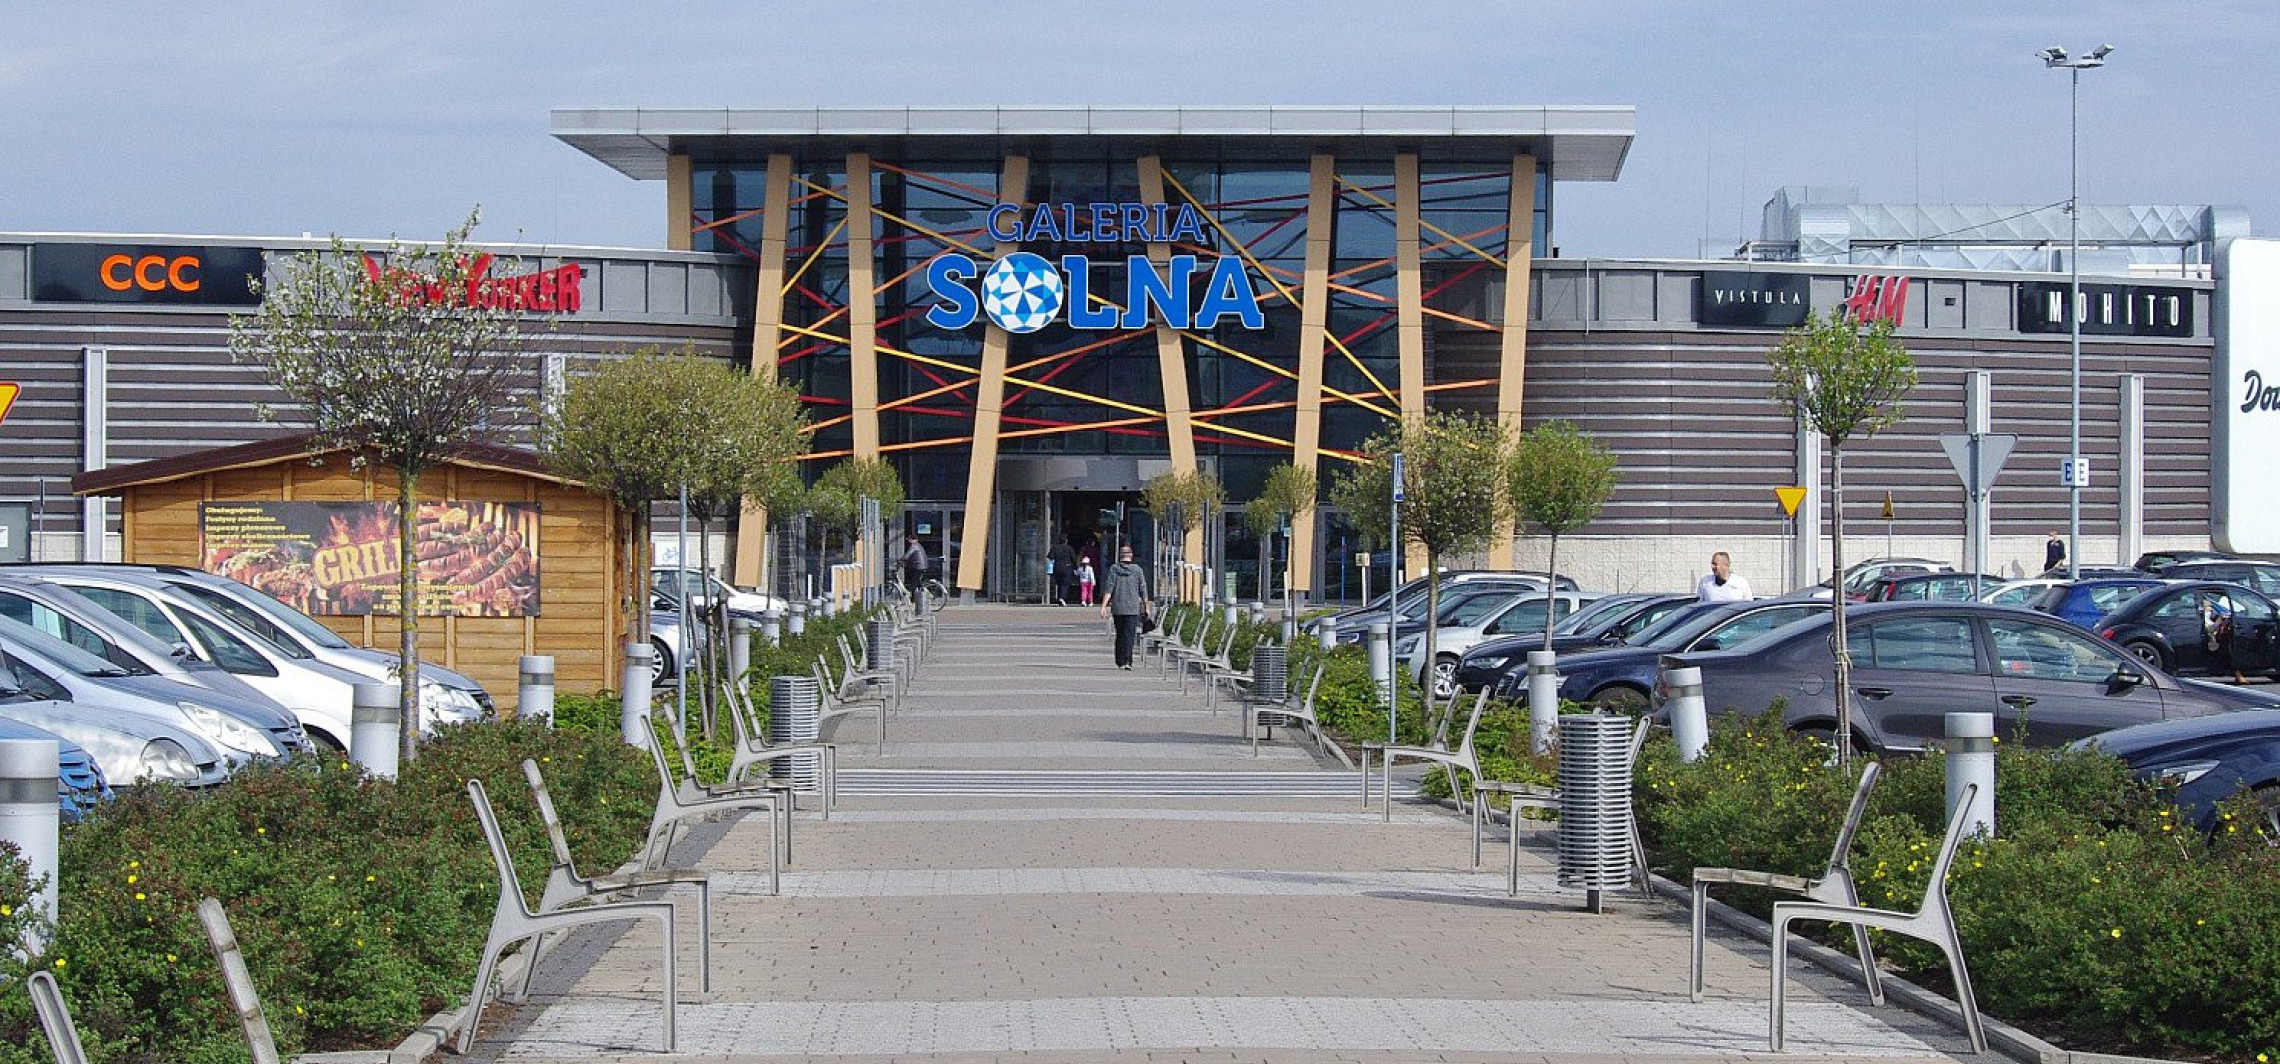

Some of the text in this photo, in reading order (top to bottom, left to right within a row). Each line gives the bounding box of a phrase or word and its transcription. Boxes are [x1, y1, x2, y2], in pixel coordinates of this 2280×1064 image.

[987, 202, 1205, 242] GALERIA
[100, 254, 200, 292] CCC
[925, 252, 1265, 334] SOLNA
[1714, 289, 1801, 305] VISTULA
[2049, 291, 2180, 327] MOHITO
[2064, 462, 2073, 482] E
